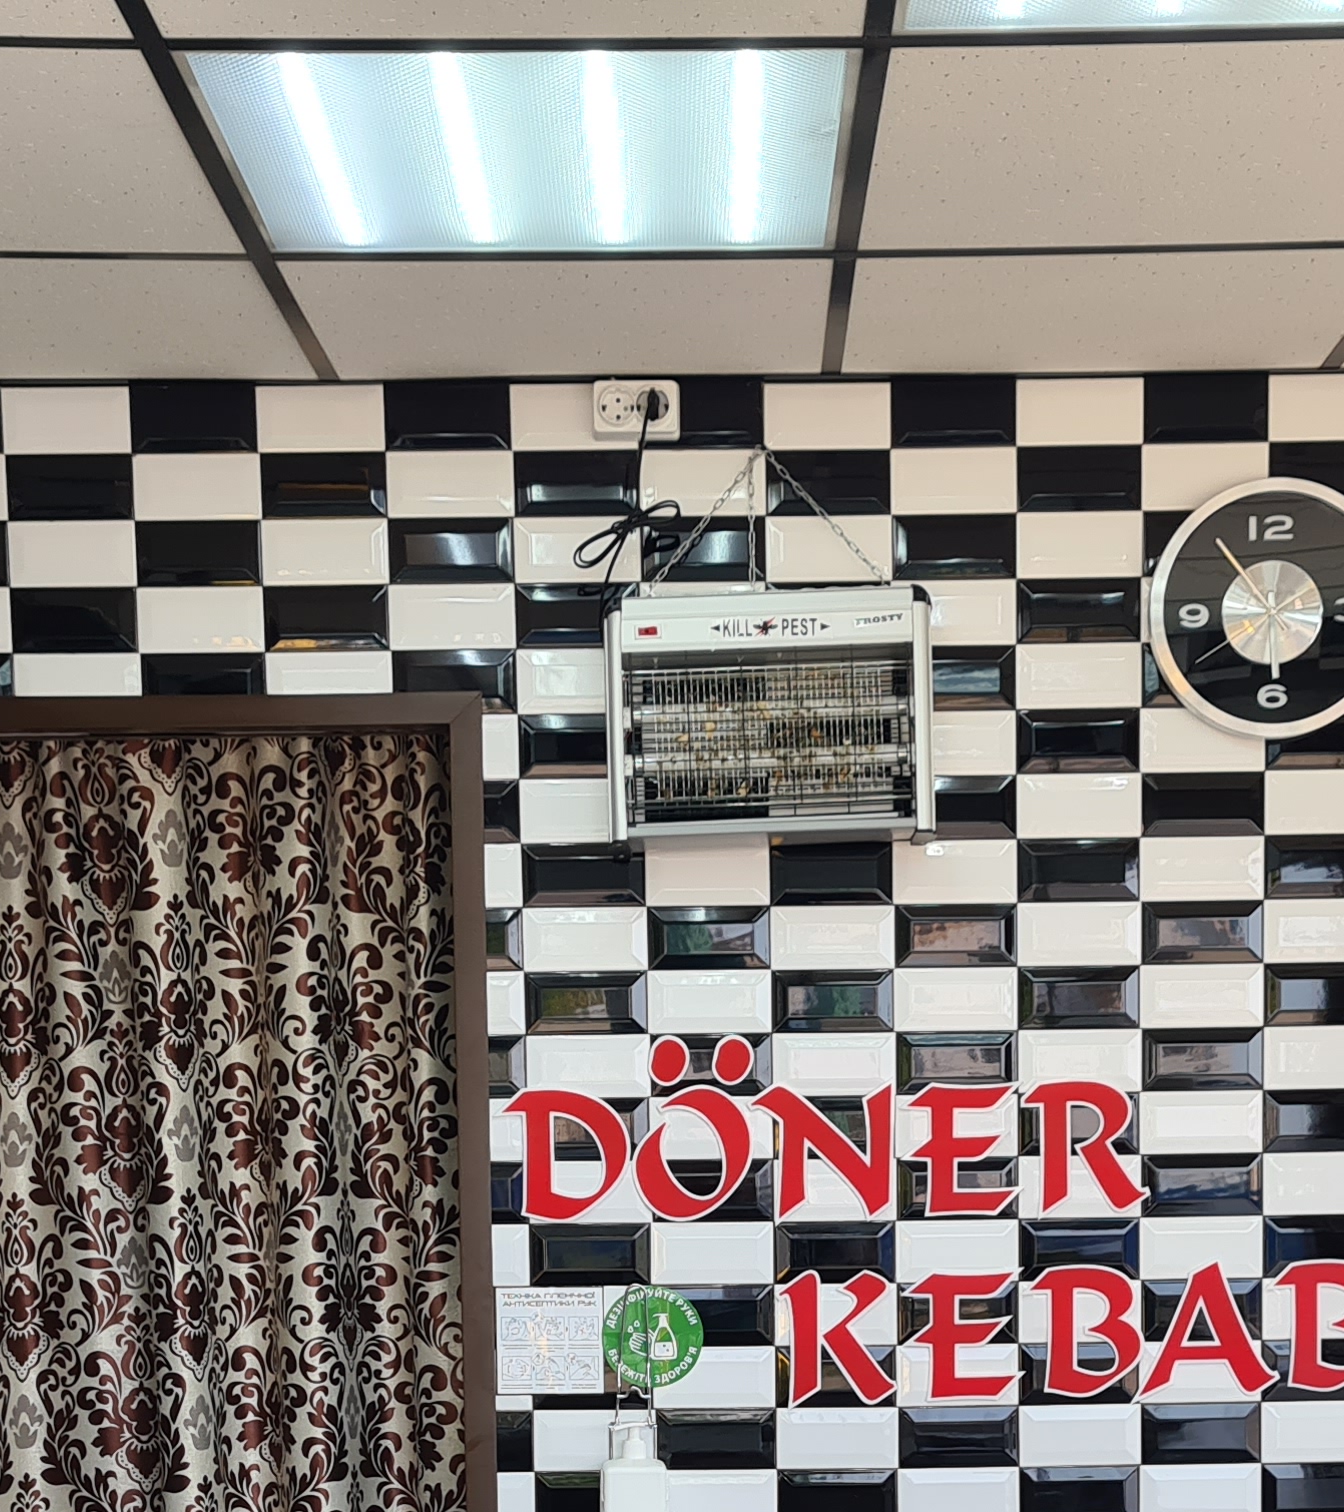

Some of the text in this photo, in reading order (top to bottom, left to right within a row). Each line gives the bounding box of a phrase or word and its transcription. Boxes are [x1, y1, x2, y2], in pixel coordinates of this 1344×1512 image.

[1248, 515, 1294, 541] 12
[722, 613, 904, 638] KILL PEST FROSTY
[1178, 603, 1210, 628] 9
[1256, 684, 1288, 709] 6
[504, 1035, 1150, 1221] DÖNER
[675, 1298, 697, 1326] РУКИ
[654, 1346, 697, 1384] ЗДОРОВ'Я
